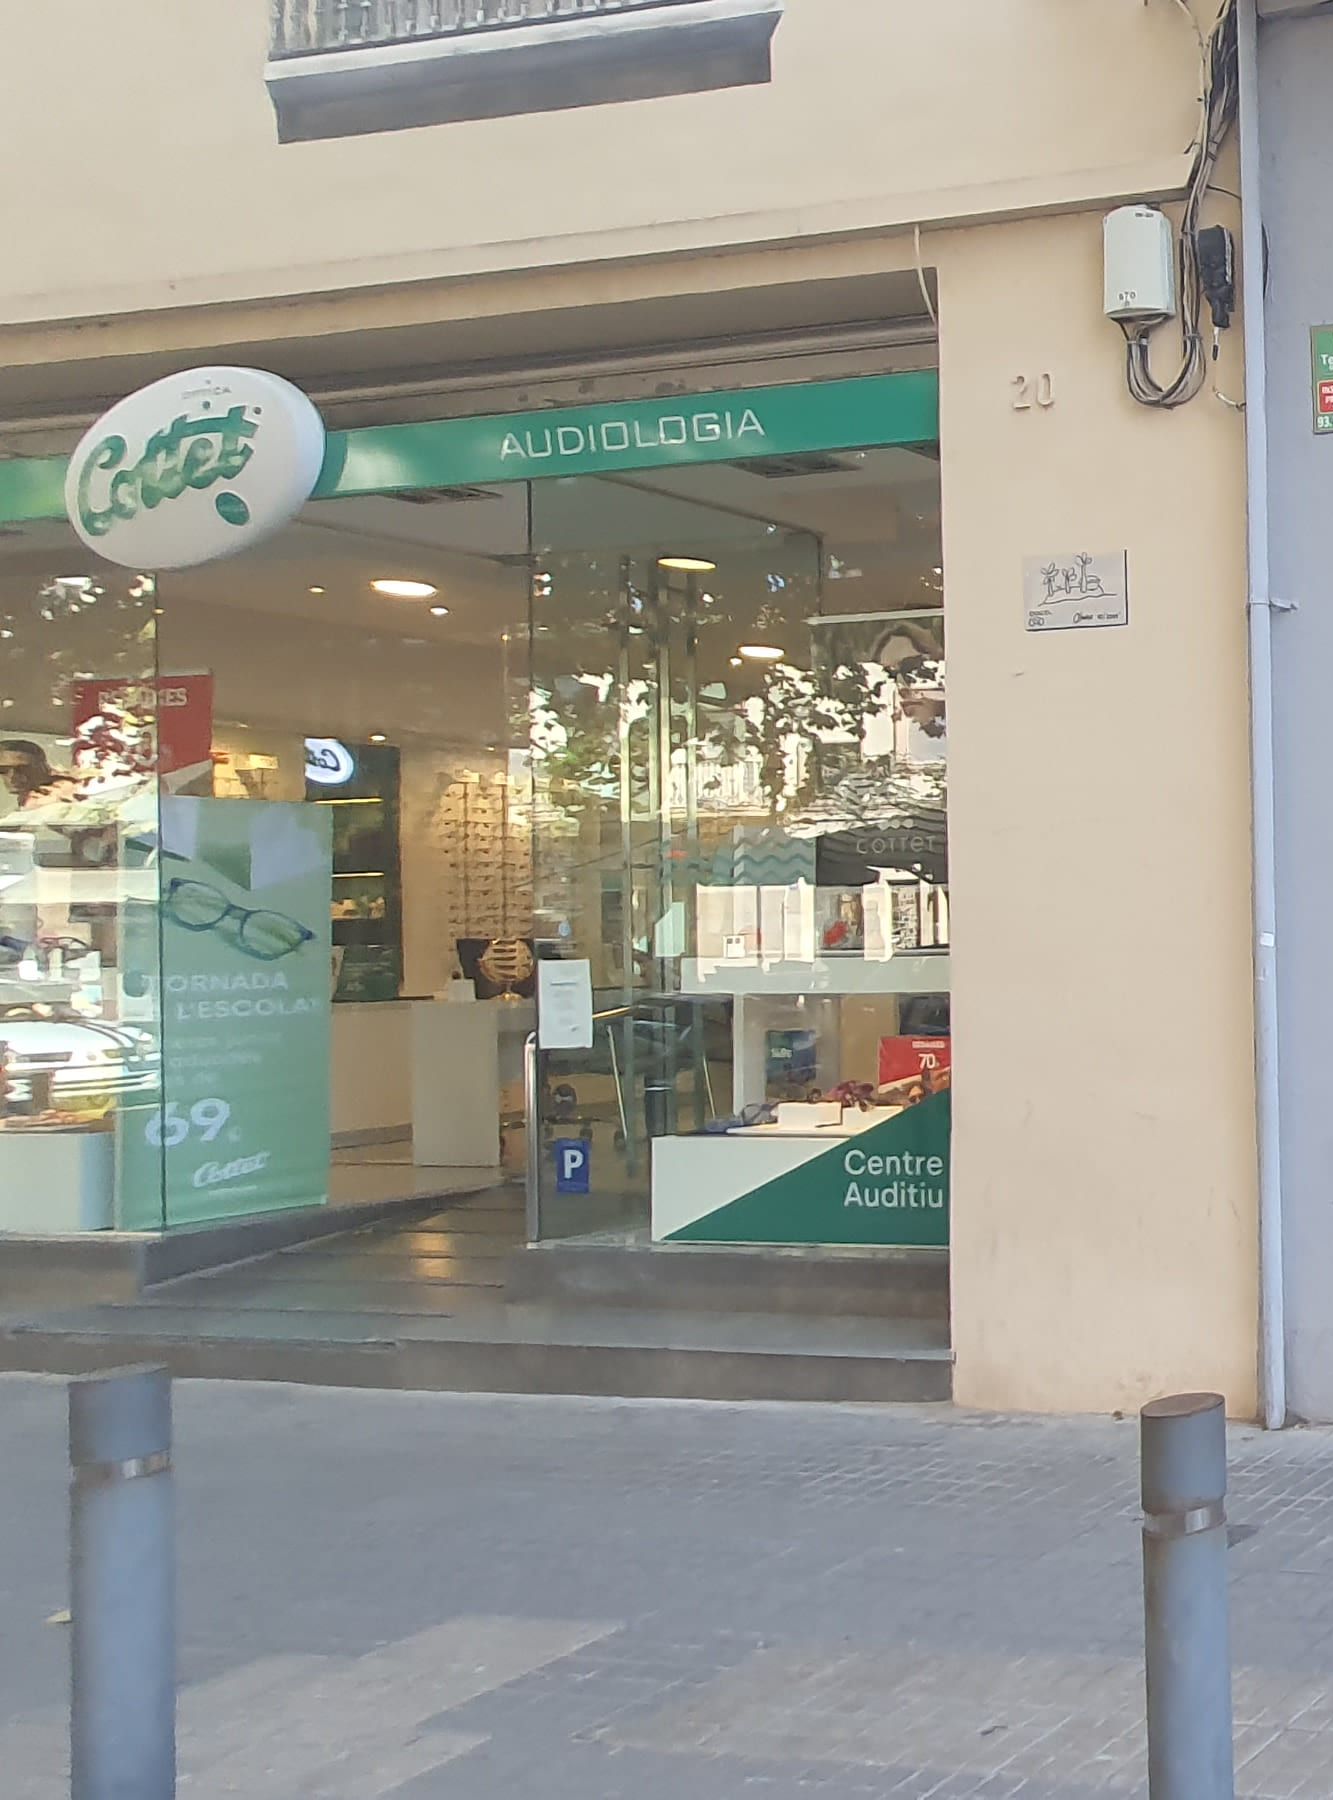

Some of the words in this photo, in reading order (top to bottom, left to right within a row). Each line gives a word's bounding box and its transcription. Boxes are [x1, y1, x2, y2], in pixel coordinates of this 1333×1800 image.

[1010, 373, 1054, 411] 20
[500, 408, 766, 461] AUDIOLOGIA
[564, 1149, 584, 1179] P
[844, 1149, 943, 1176] Centre
[844, 1181, 944, 1208] Auditiu
